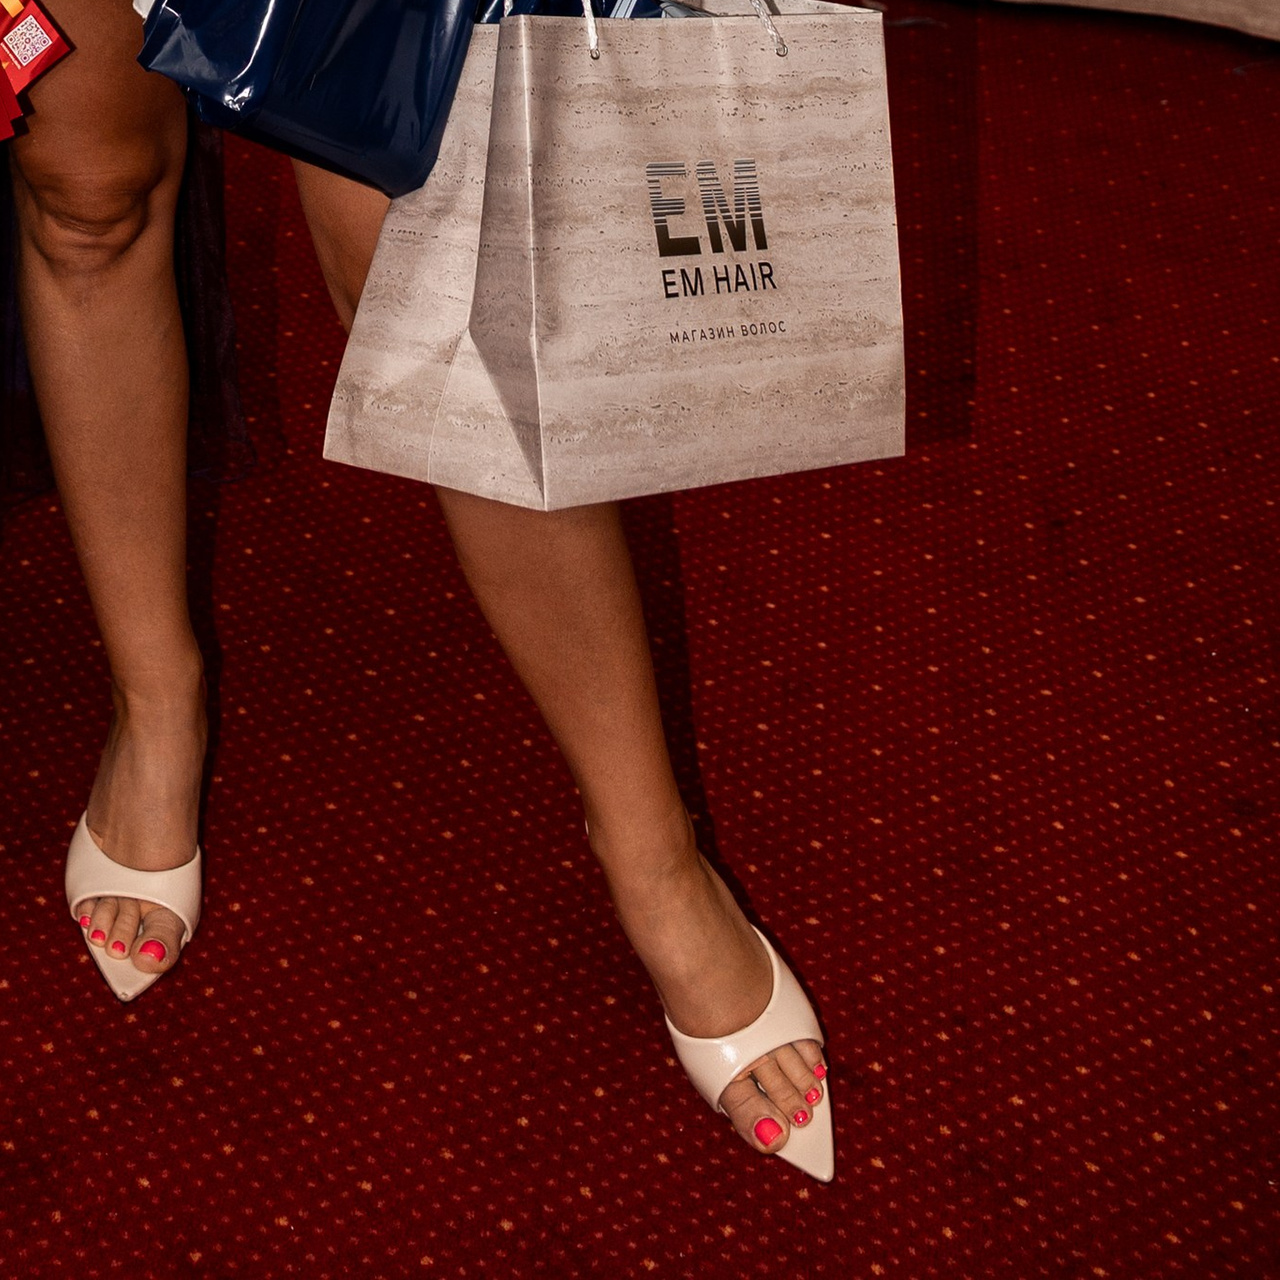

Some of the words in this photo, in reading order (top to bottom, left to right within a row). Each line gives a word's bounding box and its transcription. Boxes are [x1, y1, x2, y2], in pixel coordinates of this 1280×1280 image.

[646, 158, 769, 257] EM
[661, 267, 705, 299] EM
[712, 261, 778, 295] HAIR
[669, 325, 735, 344] МАГАЗИН
[740, 320, 787, 337] ВОЛОС
